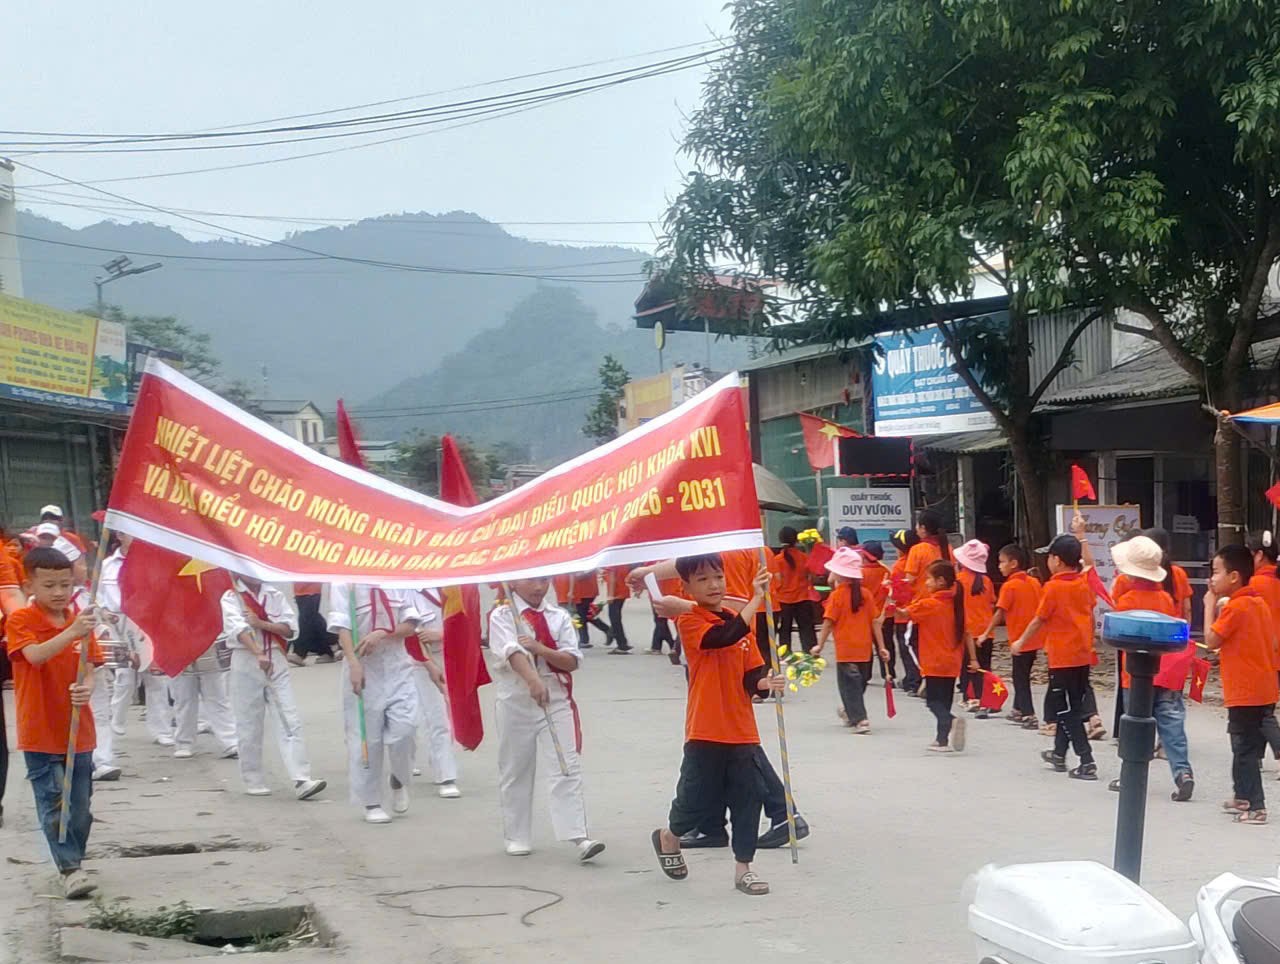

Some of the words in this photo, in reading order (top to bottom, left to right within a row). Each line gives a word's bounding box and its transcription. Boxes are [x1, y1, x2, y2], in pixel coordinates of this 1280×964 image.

[143, 463, 170, 499] VÀ
[197, 489, 245, 529] BIỂU
[244, 513, 286, 548] HỘI
[284, 529, 346, 566] ĐỒNG
[344, 545, 403, 570] NHÂN
[621, 488, 662, 525] 2026
[679, 477, 727, 513] 2031
[154, 415, 208, 463] NHIỆT
[205, 448, 254, 486] LIỆT
[307, 494, 372, 534] MỪNG
[371, 516, 430, 549] NGÀY
[570, 472, 613, 511] QUỐC
[616, 463, 644, 496] HỘI
[646, 440, 686, 477] KHÓA
[689, 425, 722, 459] XVI
[842, 504, 864, 516] DUY
[864, 503, 902, 516] VƯƠNG
